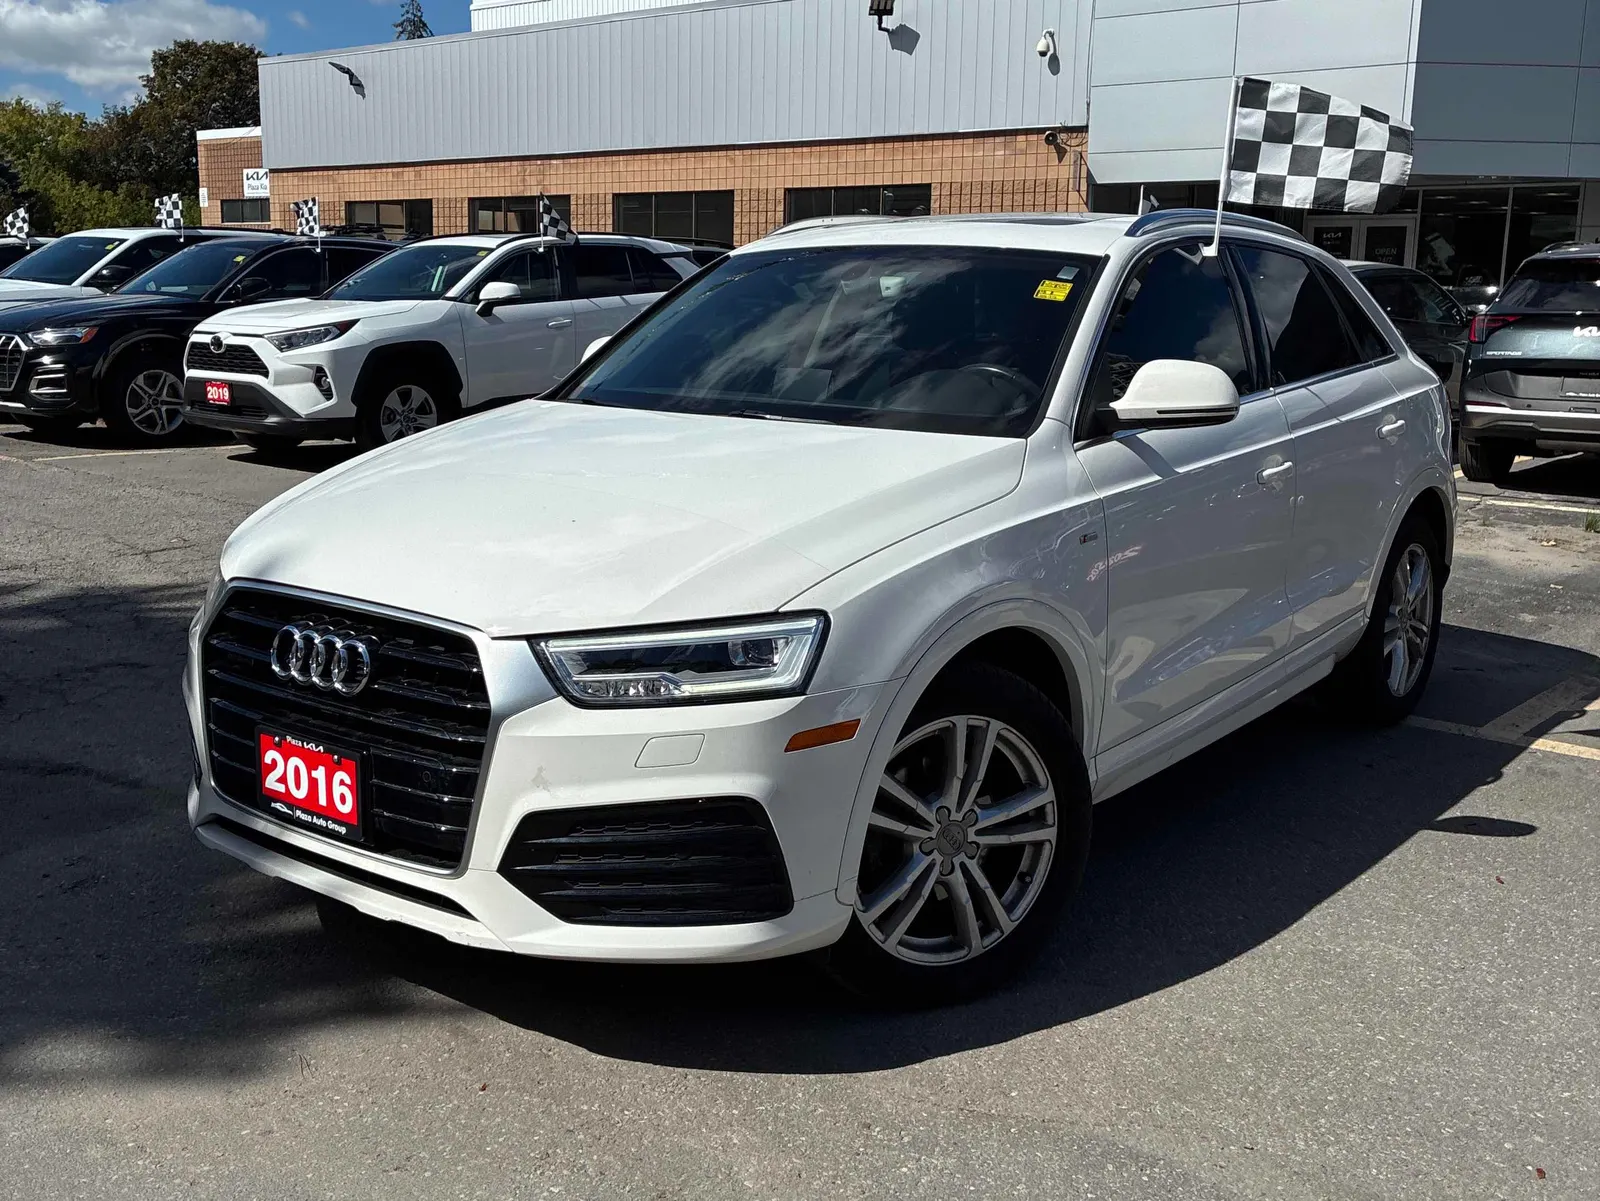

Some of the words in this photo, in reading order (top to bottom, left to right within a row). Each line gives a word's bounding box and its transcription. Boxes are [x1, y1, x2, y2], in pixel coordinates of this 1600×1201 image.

[246, 171, 269, 181] KIA
[247, 183, 260, 191] Plaza
[1375, 247, 1397, 255] OPEN
[207, 386, 229, 400] 2019
[286, 735, 302, 747] Plaza
[303, 741, 324, 753] KIA
[264, 750, 353, 814] 2016
[295, 809, 312, 822] Plaza
[312, 815, 327, 827] Auto
[327, 821, 347, 835] Group
